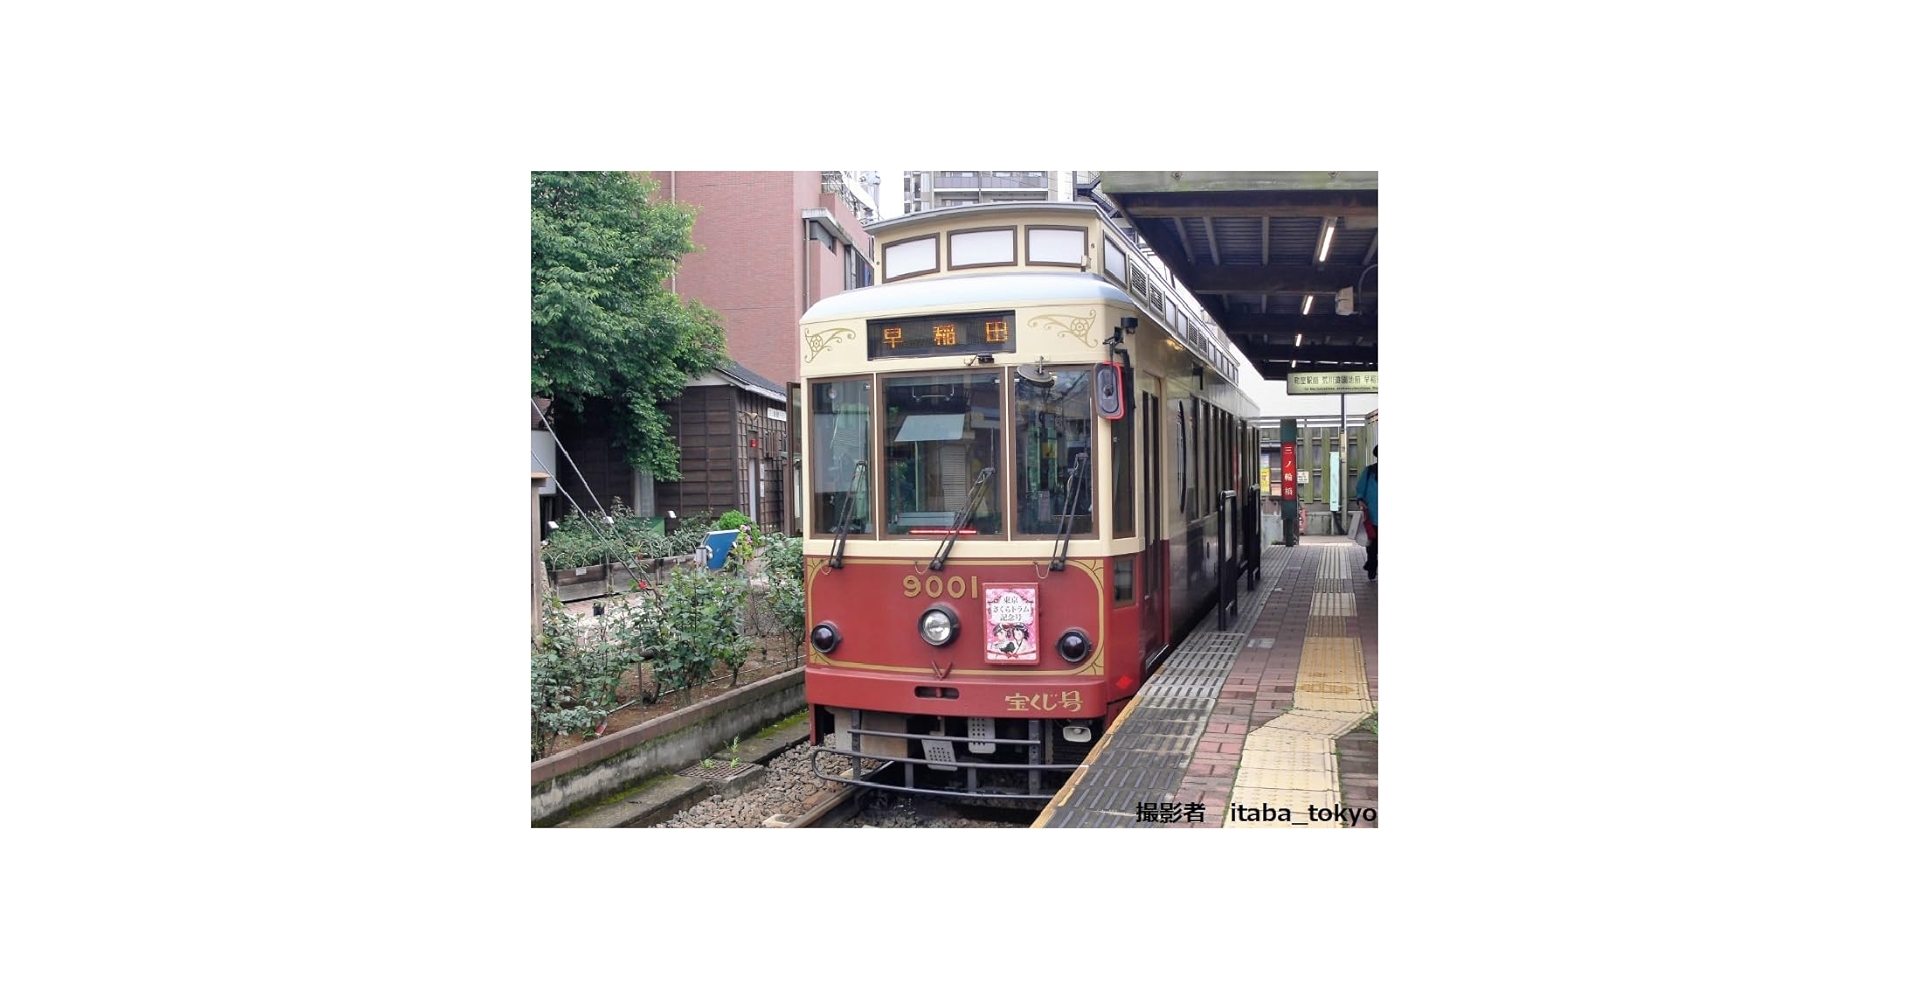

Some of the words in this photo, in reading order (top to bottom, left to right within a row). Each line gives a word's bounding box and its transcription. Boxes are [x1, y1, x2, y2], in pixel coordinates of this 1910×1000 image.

[1284, 446, 1294, 496] 三ノ輪橋
[902, 574, 979, 599] 9001
[993, 605, 1030, 613] さくらトラム
[1004, 690, 1084, 713] 宝くじ号
